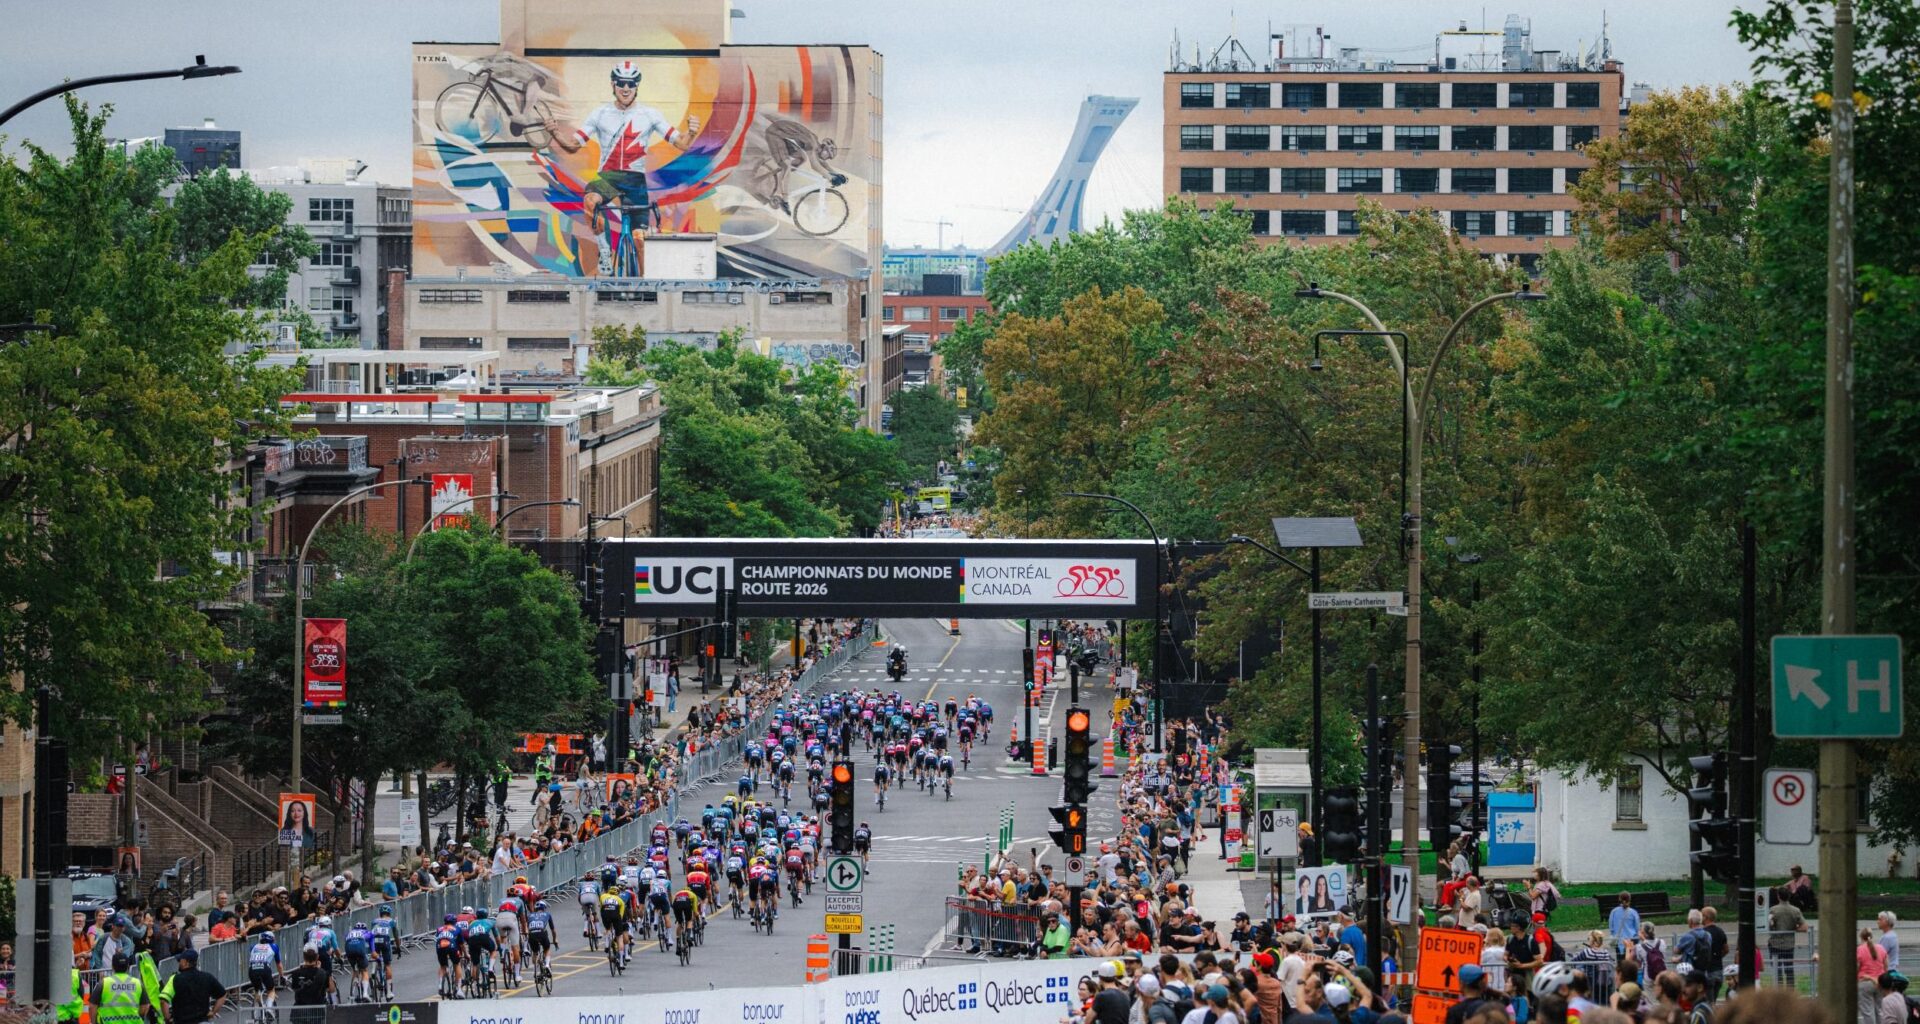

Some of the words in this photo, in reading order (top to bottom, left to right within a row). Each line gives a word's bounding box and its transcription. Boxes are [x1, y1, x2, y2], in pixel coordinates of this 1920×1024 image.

[741, 565, 864, 579] CHAMPIONNATS
[866, 566, 890, 579] DU
[893, 566, 952, 579] MONDE
[971, 564, 1052, 579] MONTRÉAL
[653, 565, 726, 595] UCI
[741, 582, 792, 596] ROUTE
[794, 582, 829, 596] 2026
[971, 583, 1032, 596] CANADA
[1312, 596, 1386, 608] Côte-Sainte-Catherine
[1846, 659, 1891, 713] H
[827, 896, 860, 904] EXCEPTÉ
[1425, 935, 1476, 955] DÉTOUR
[111, 983, 137, 991] CADET
[844, 988, 881, 1008] bonjour
[902, 986, 957, 1021] Québec
[984, 979, 1043, 1014] Québec
[665, 1008, 700, 1024] bonjour
[743, 1002, 784, 1020] bonjour
